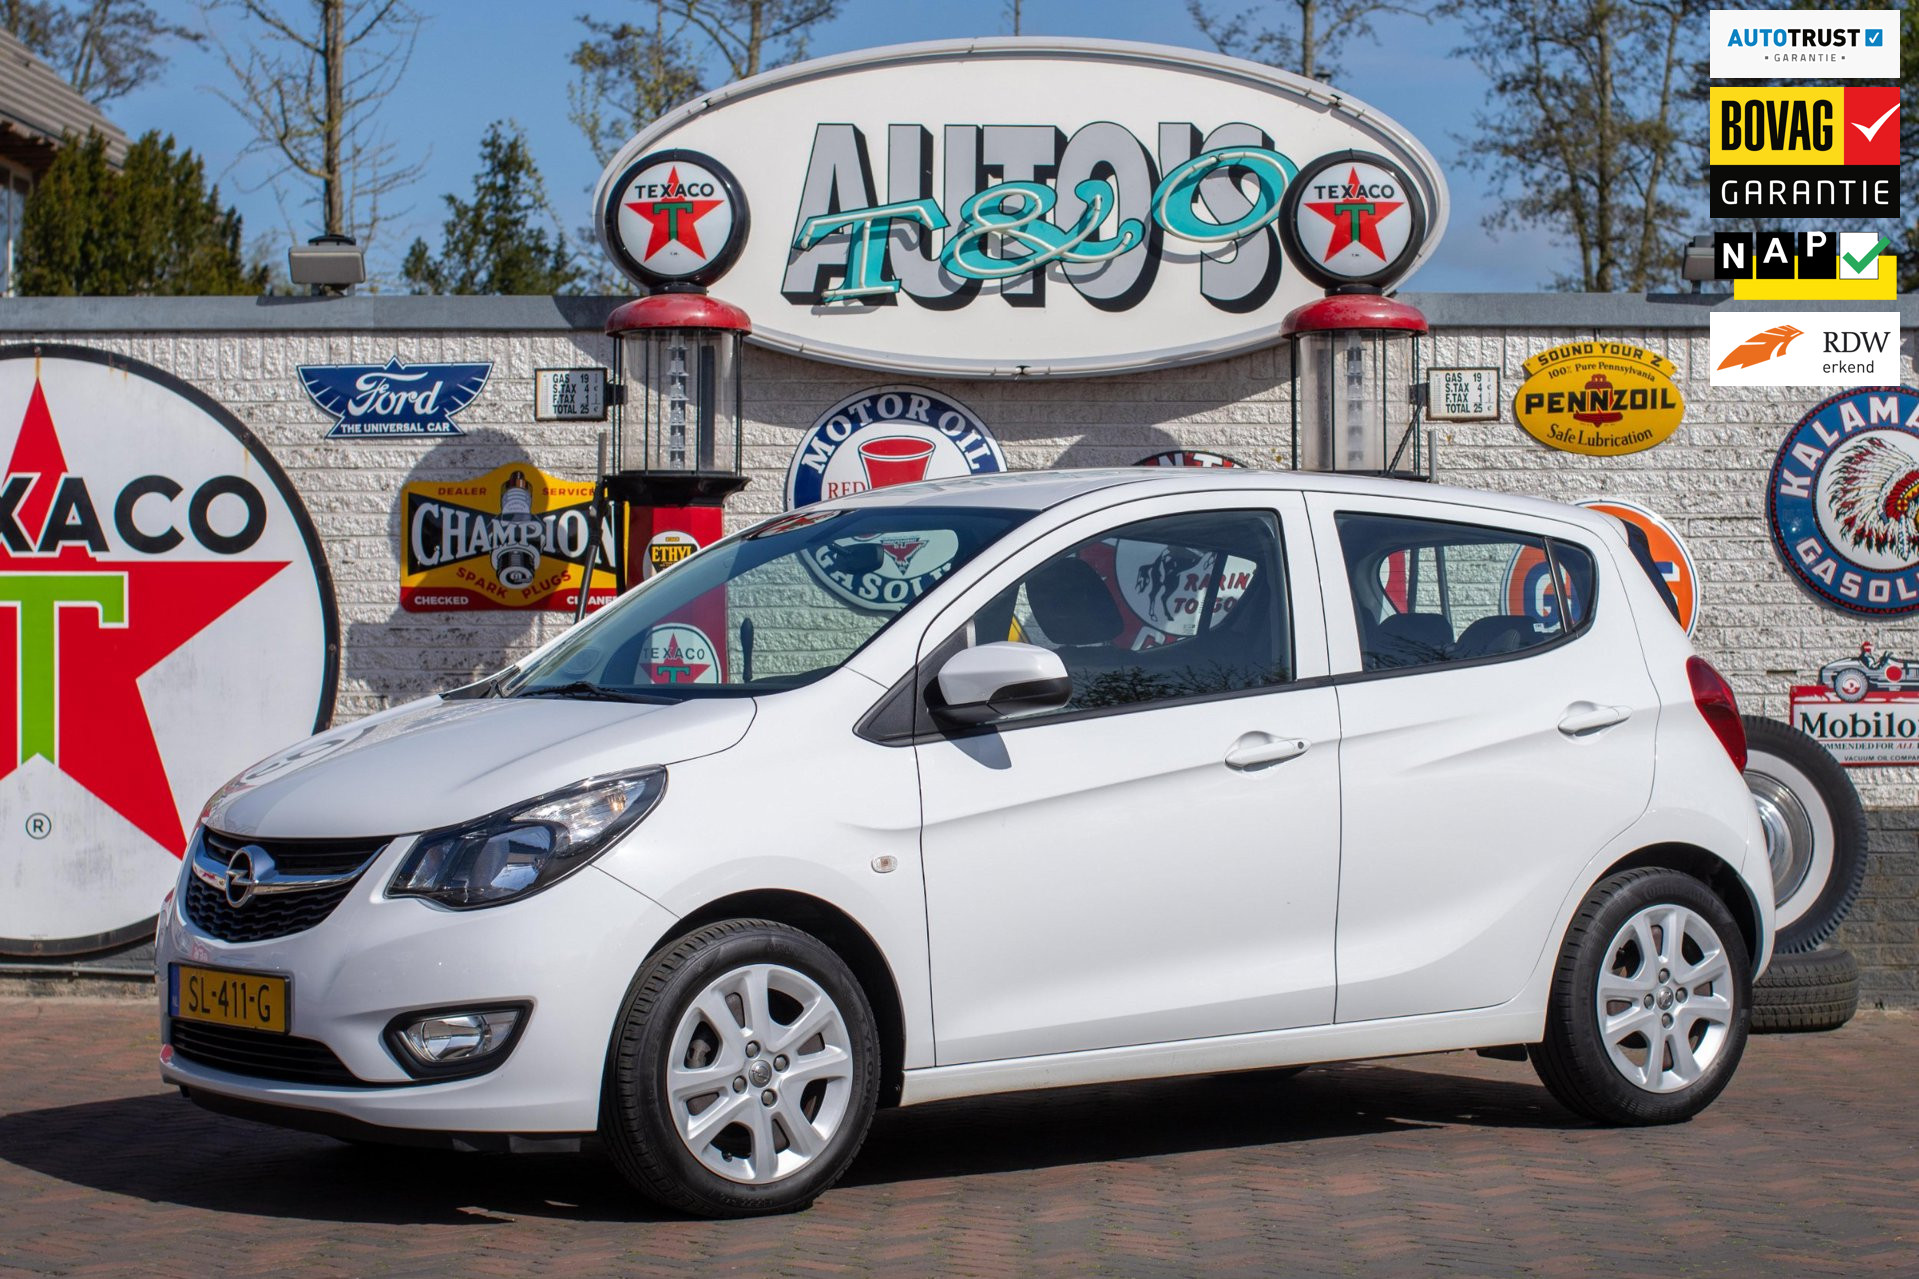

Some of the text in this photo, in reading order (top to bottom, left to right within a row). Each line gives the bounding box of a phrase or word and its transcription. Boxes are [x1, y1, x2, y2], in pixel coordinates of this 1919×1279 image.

[635, 183, 714, 199] TEXACO
[1314, 184, 1394, 199] TEXACO
[1538, 343, 1663, 367] SOUND YOUR Z
[553, 374, 570, 383] GAS
[580, 374, 589, 383] 19
[1445, 373, 1462, 382] GAS
[1473, 373, 1482, 382] 19
[1575, 362, 1596, 372] Pure
[1598, 361, 1656, 382] Pennsylvania
[553, 384, 576, 393] S.TAX
[584, 384, 589, 393] 4
[1445, 383, 1469, 393] S.TAX
[1477, 383, 1482, 392] 4
[553, 394, 575, 403] F.TAX
[1445, 393, 1468, 403] F.TAX
[1525, 387, 1676, 415] PENNZOIL
[553, 404, 577, 414] TOTAL
[580, 404, 589, 414] 25
[1445, 403, 1470, 413] TOTAL
[1473, 403, 1483, 413] 25
[341, 422, 450, 433] THE UNIVERSAL CAR
[801, 393, 991, 475] MOTOR OIL
[1547, 423, 1653, 447] Safe Lubrication
[438, 487, 487, 496] DEALER
[411, 501, 617, 569] CHAMPION
[1796, 537, 1919, 603] GASOL
[456, 567, 572, 600] SPARK PLUGS
[414, 596, 468, 605] CHECKED
[1174, 597, 1199, 614] TO
[643, 647, 705, 660] TEXACO
[1800, 711, 1919, 738] Mobilo
[189, 975, 271, 1022] SL-411-G
